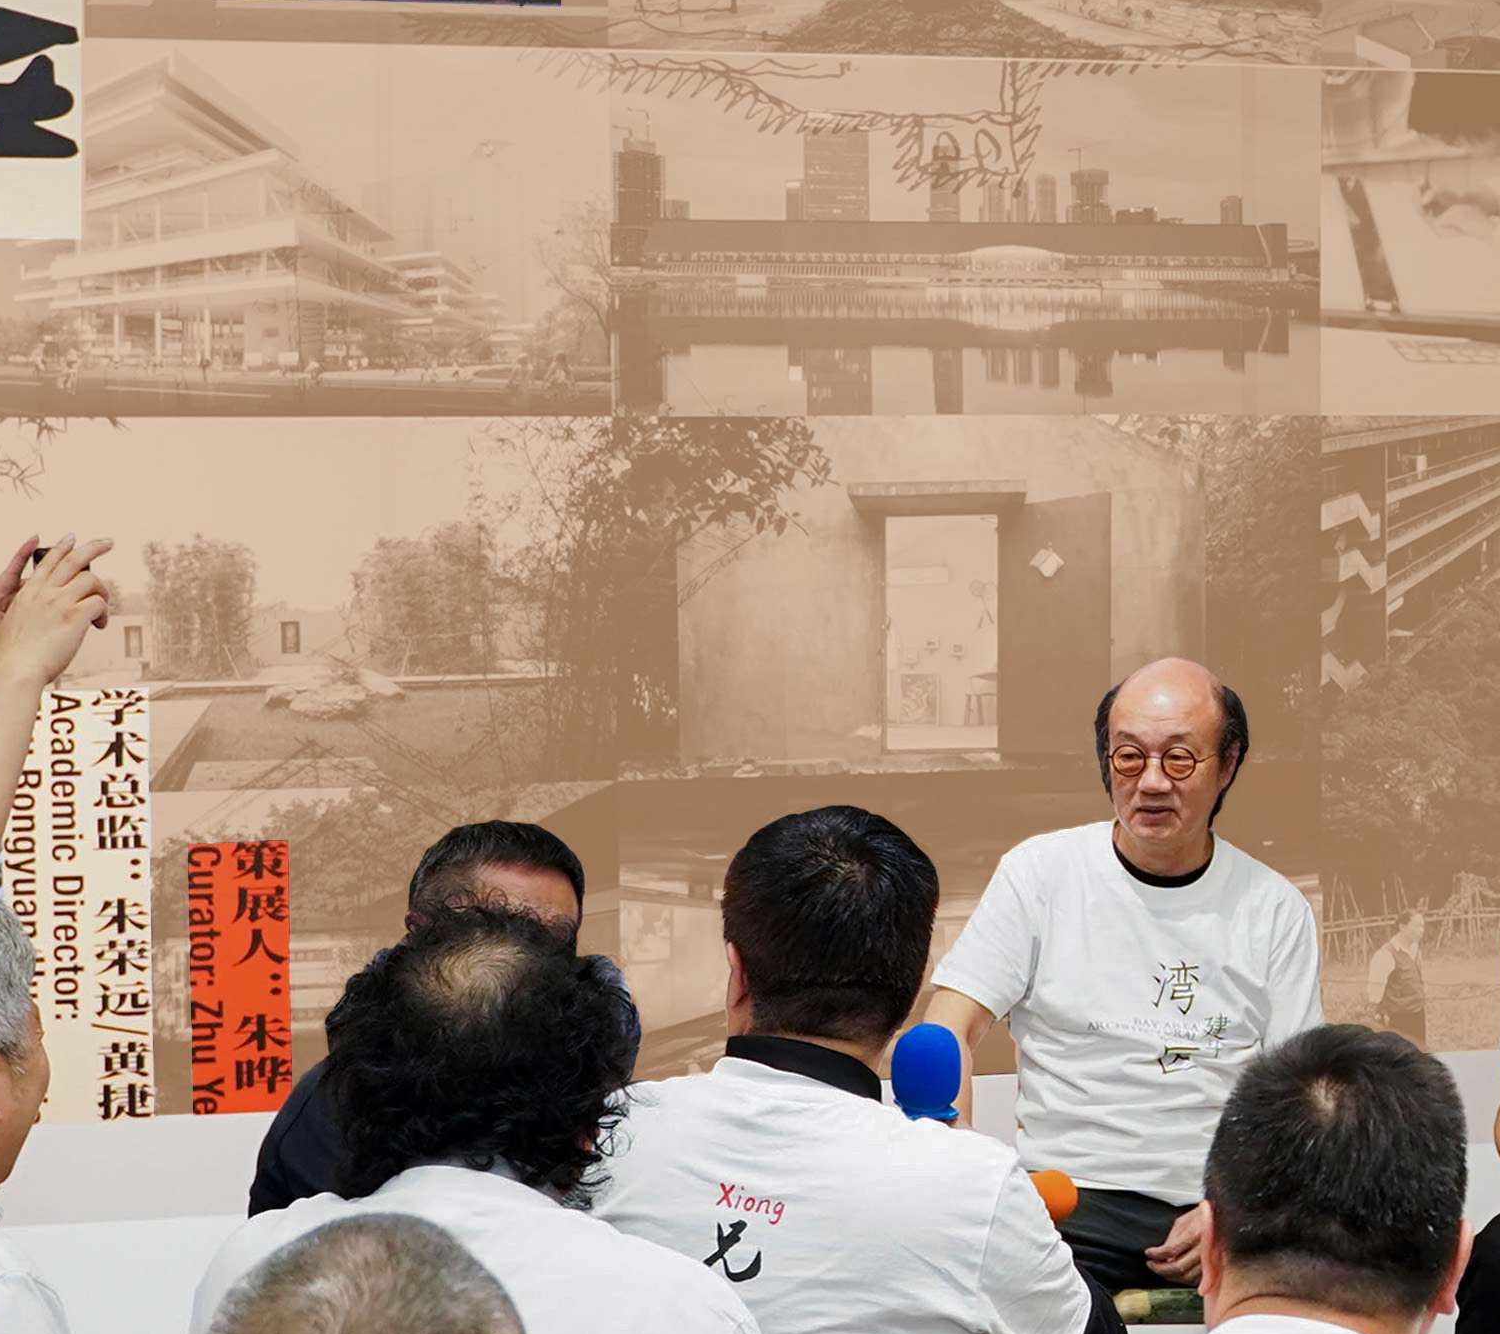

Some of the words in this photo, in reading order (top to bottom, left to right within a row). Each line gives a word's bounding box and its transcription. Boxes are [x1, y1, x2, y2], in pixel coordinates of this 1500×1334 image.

[50, 692, 83, 862] Academic
[51, 874, 84, 1021] Director:
[187, 845, 222, 987] Curator:
[1151, 959, 1201, 1016] 湾
[189, 999, 224, 1065] Zhu
[193, 1075, 226, 1116] Ye
[715, 1182, 786, 1226] Xiong
[703, 1219, 762, 1283] 兄
